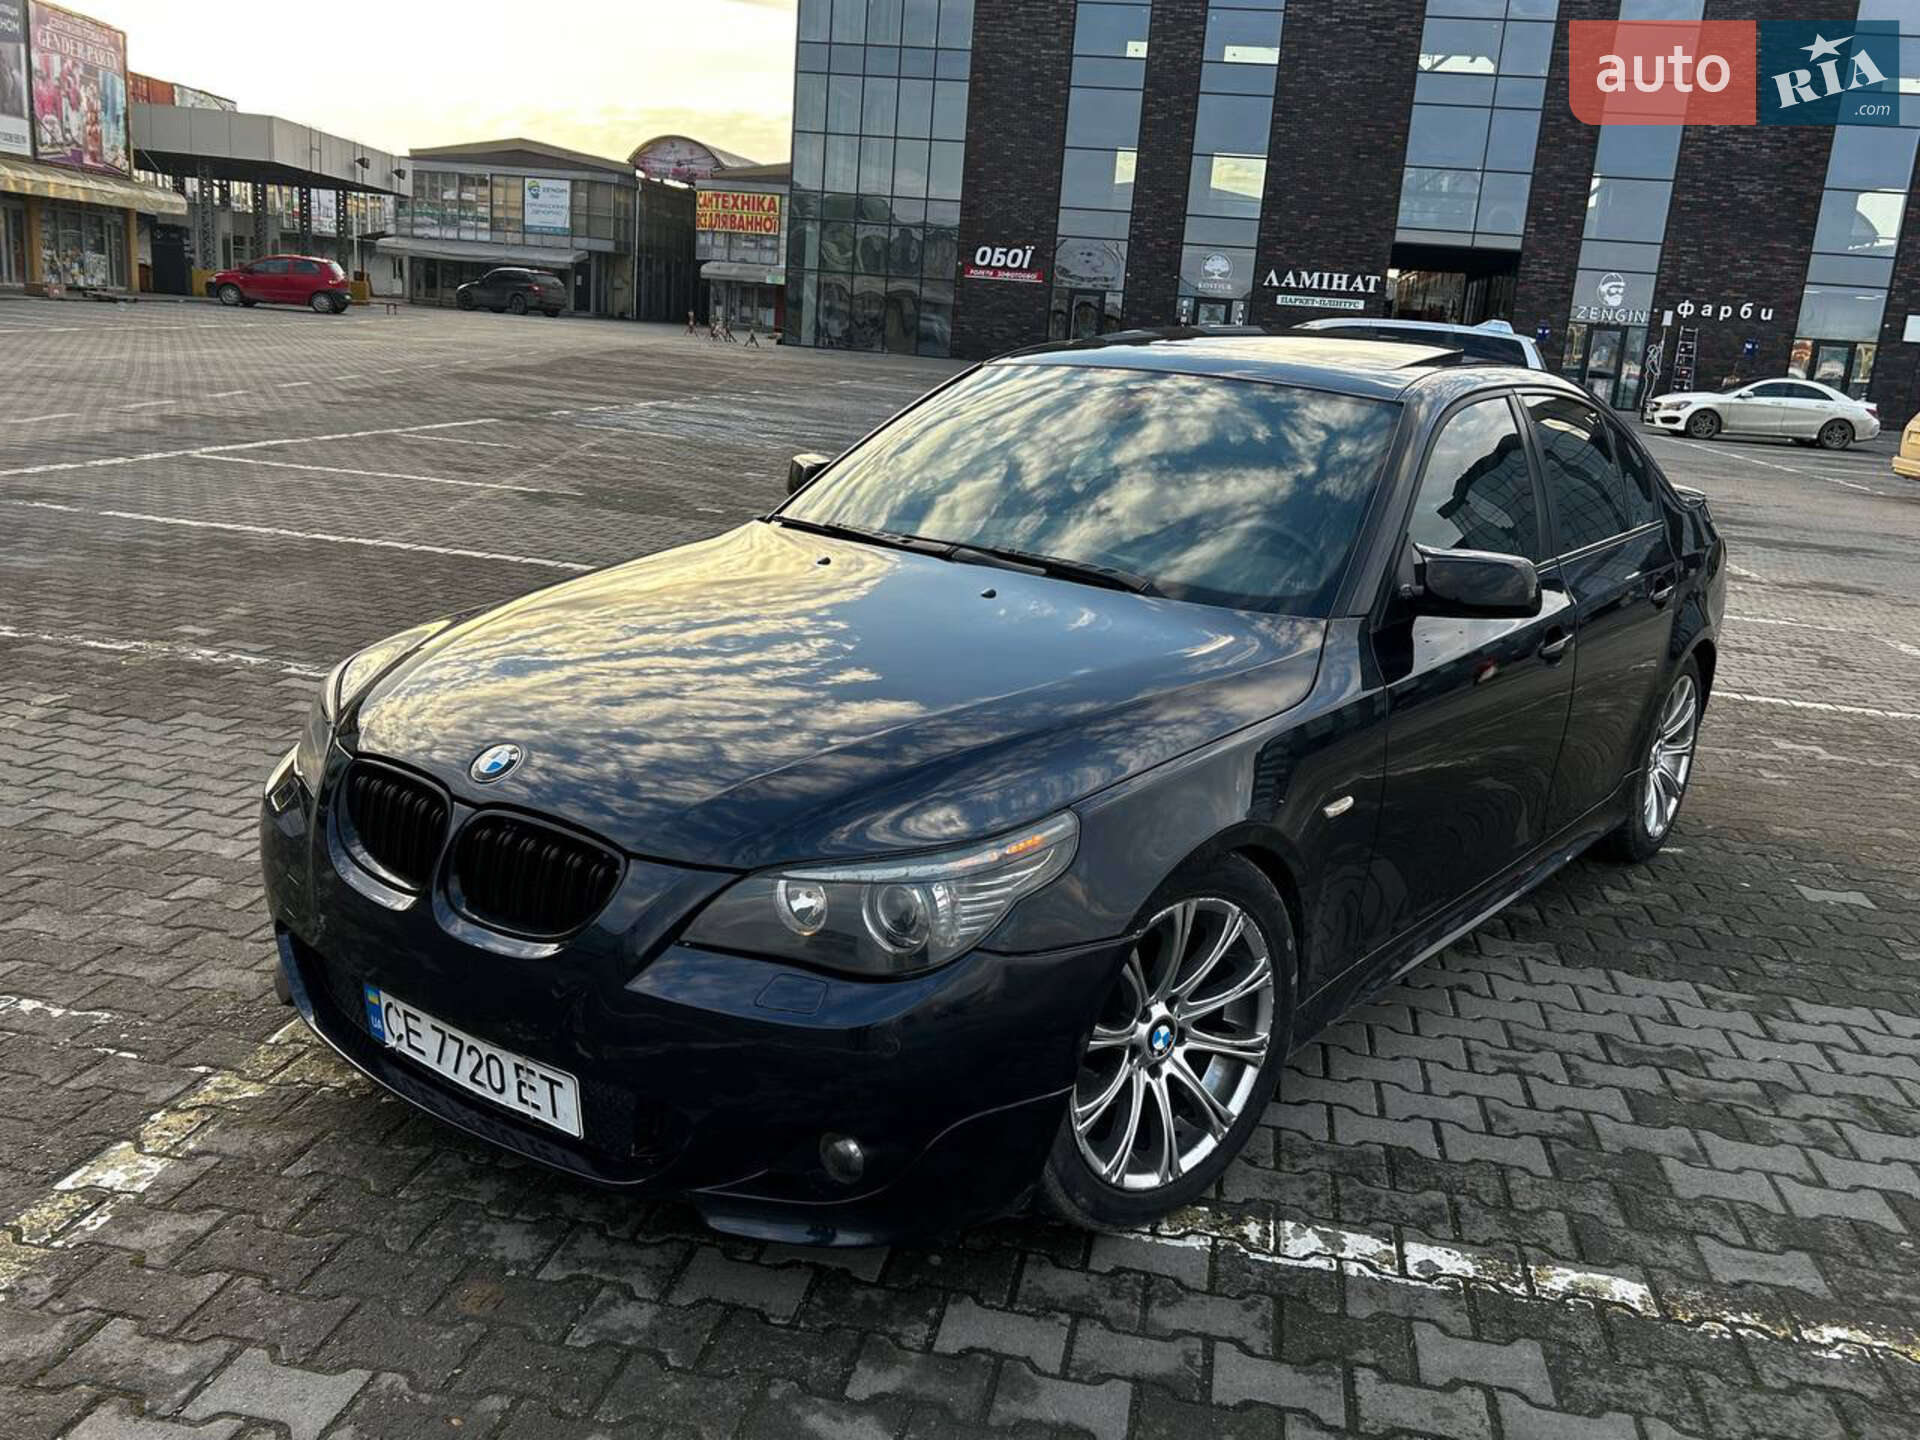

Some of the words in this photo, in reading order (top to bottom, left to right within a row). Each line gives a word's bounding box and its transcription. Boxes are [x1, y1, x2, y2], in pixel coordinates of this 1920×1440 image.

[697, 191, 778, 214] САНТЕХНІКА
[974, 244, 1036, 269] ОБОЇ
[1262, 268, 1381, 294] ЛАМІНАТ
[1576, 305, 1647, 323] ZENGIN
[384, 1001, 426, 1057] CE
[431, 1023, 506, 1095] 7720
[514, 1062, 564, 1119] ET
